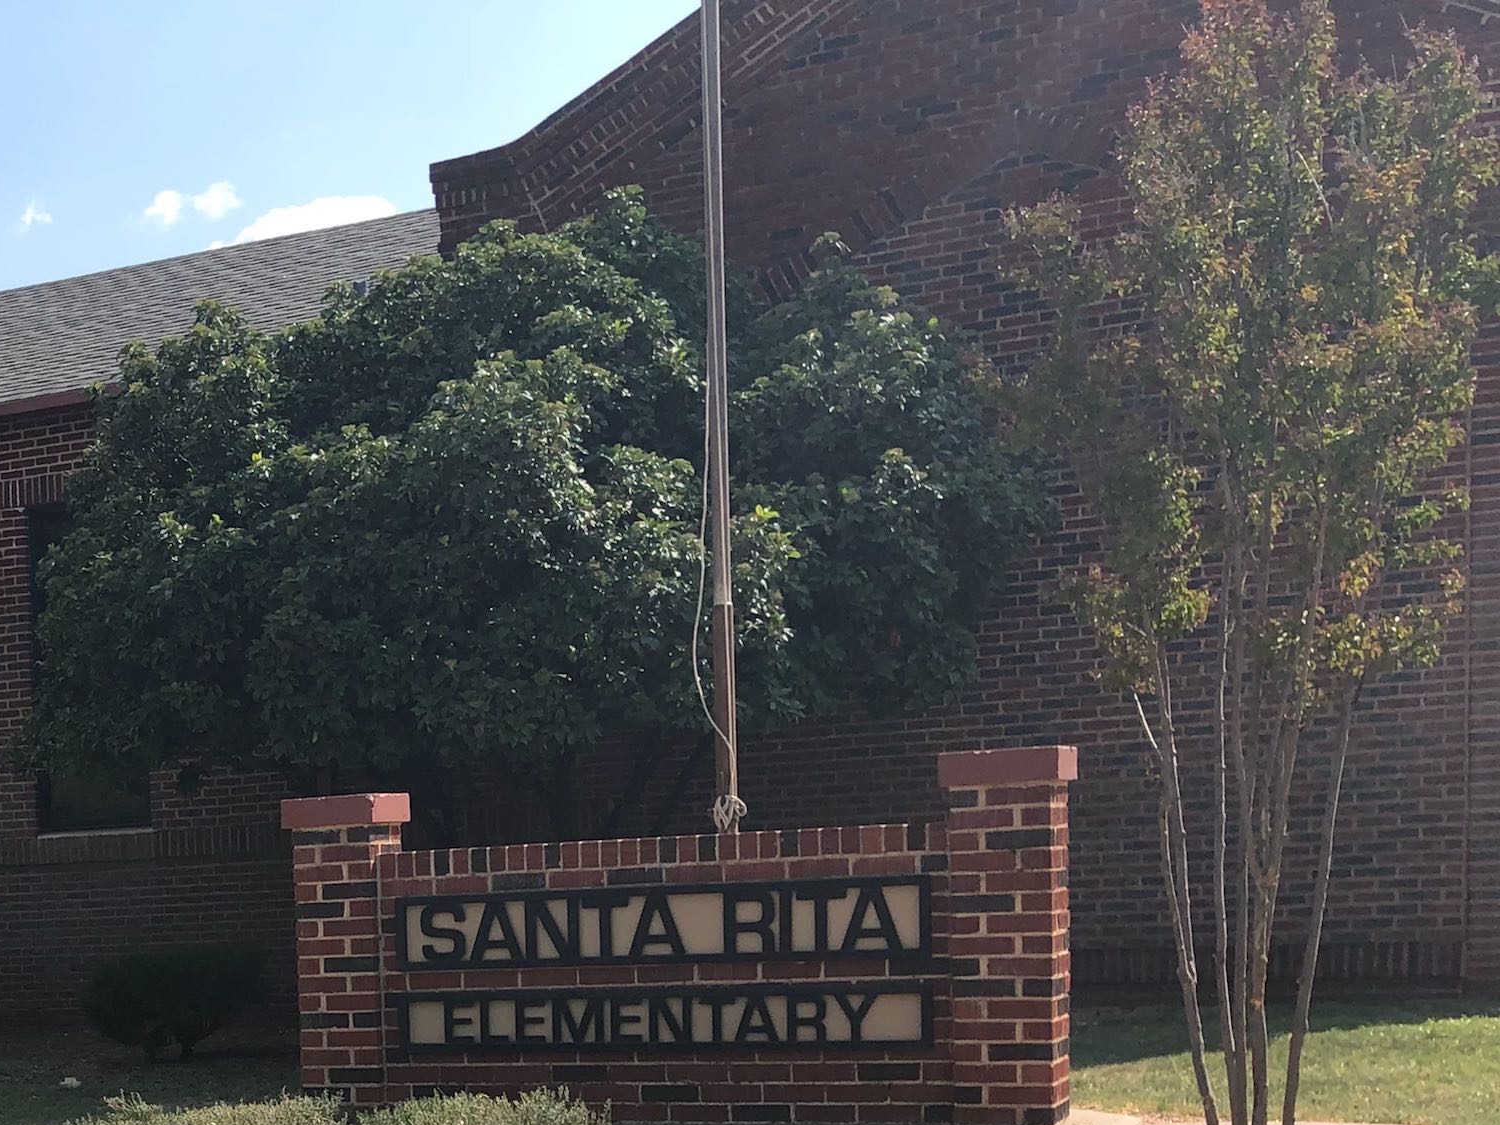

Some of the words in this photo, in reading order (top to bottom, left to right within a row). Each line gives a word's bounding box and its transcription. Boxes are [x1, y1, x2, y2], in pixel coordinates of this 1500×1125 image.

[419, 891, 686, 963] SANTA
[723, 884, 904, 954] RITA
[443, 993, 879, 1045] ELEMENTARY
